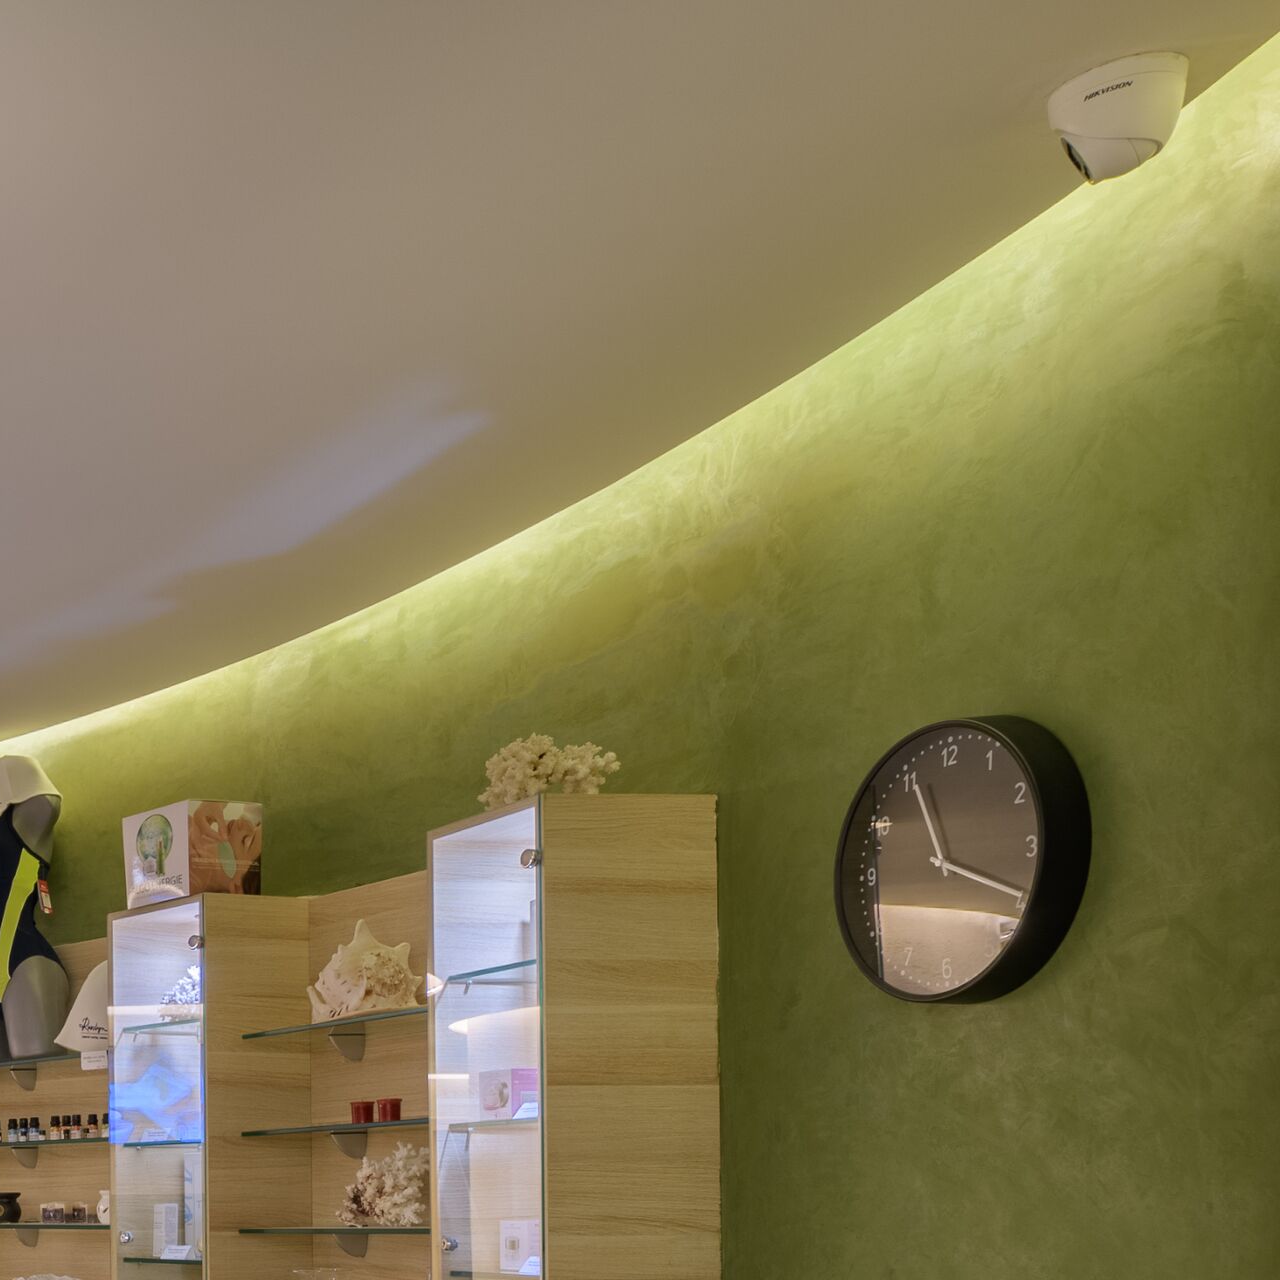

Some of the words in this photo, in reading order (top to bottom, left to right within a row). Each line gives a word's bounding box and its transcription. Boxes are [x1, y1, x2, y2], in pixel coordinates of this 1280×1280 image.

[1083, 80, 1134, 102] HIKVISION
[941, 745, 958, 768] 12
[985, 749, 993, 771] 1
[903, 771, 917, 793] 11
[1013, 782, 1026, 805] 2
[1026, 835, 1038, 858] 3
[867, 867, 876, 886] 9
[904, 947, 913, 966] 7
[942, 958, 953, 979] 6
